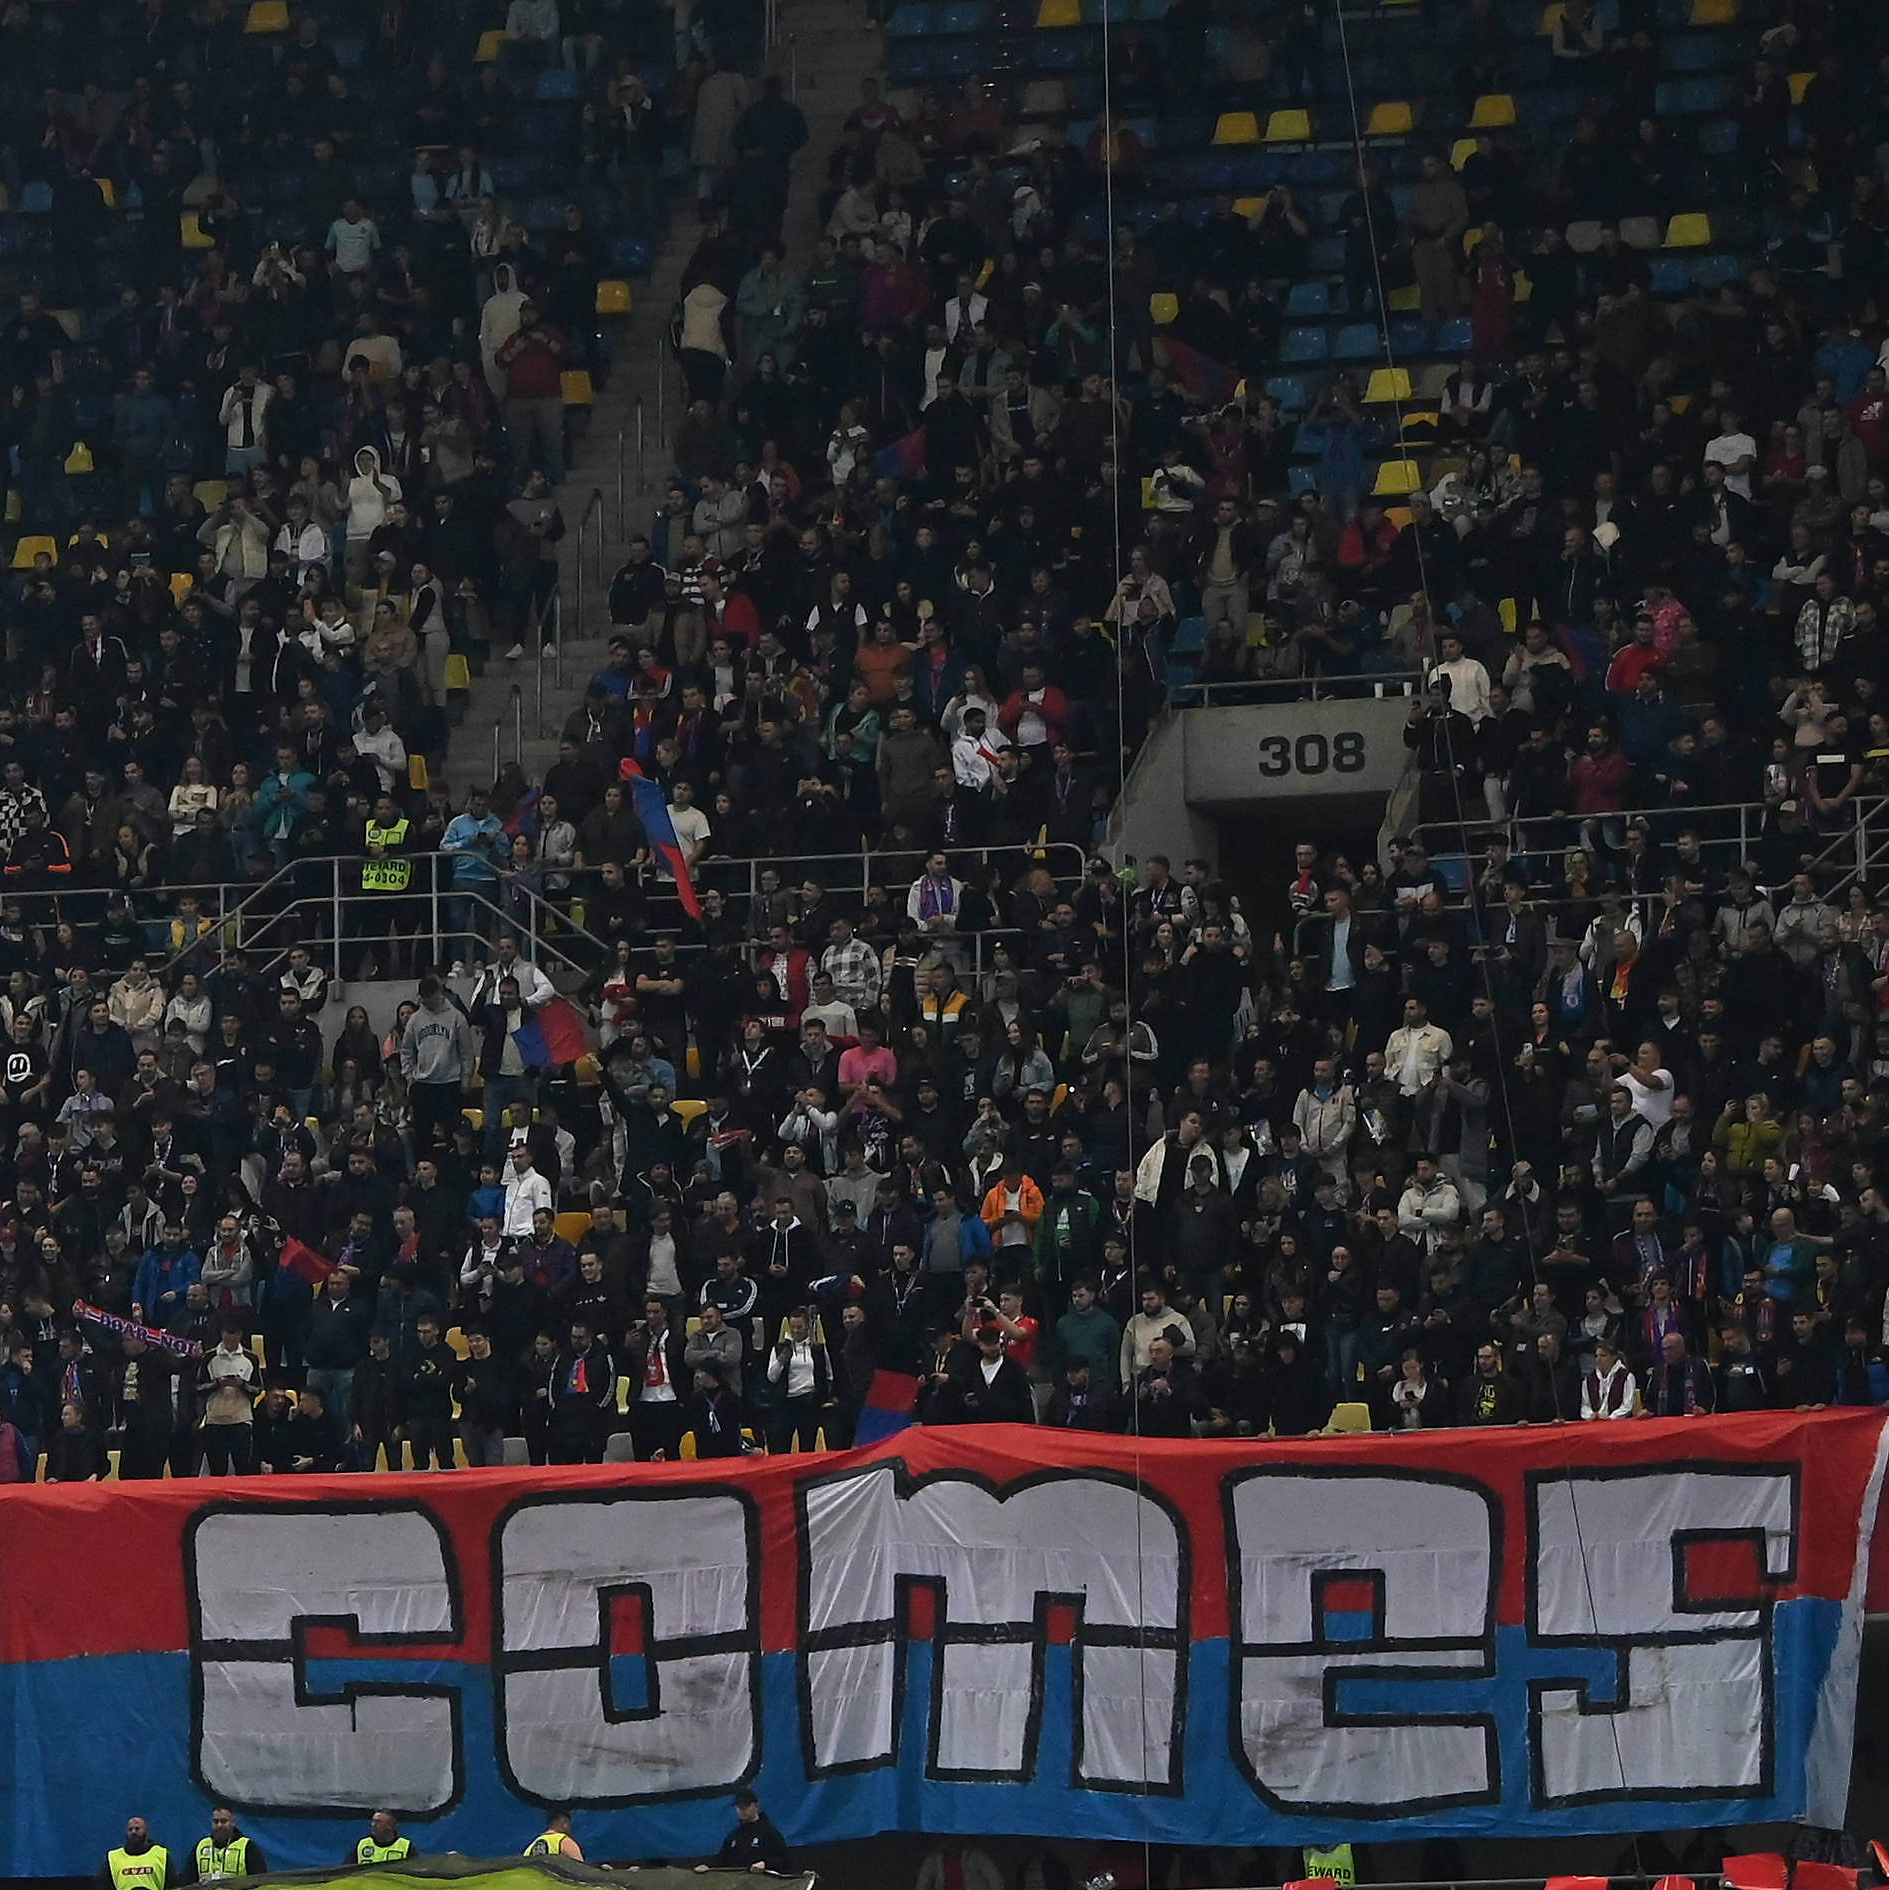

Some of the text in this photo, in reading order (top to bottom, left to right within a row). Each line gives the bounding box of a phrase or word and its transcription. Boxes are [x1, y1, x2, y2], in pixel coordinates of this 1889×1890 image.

[1258, 732, 1366, 777] 308
[184, 1456, 1803, 1823] comes
[1307, 1866, 1351, 1879] EWARD
